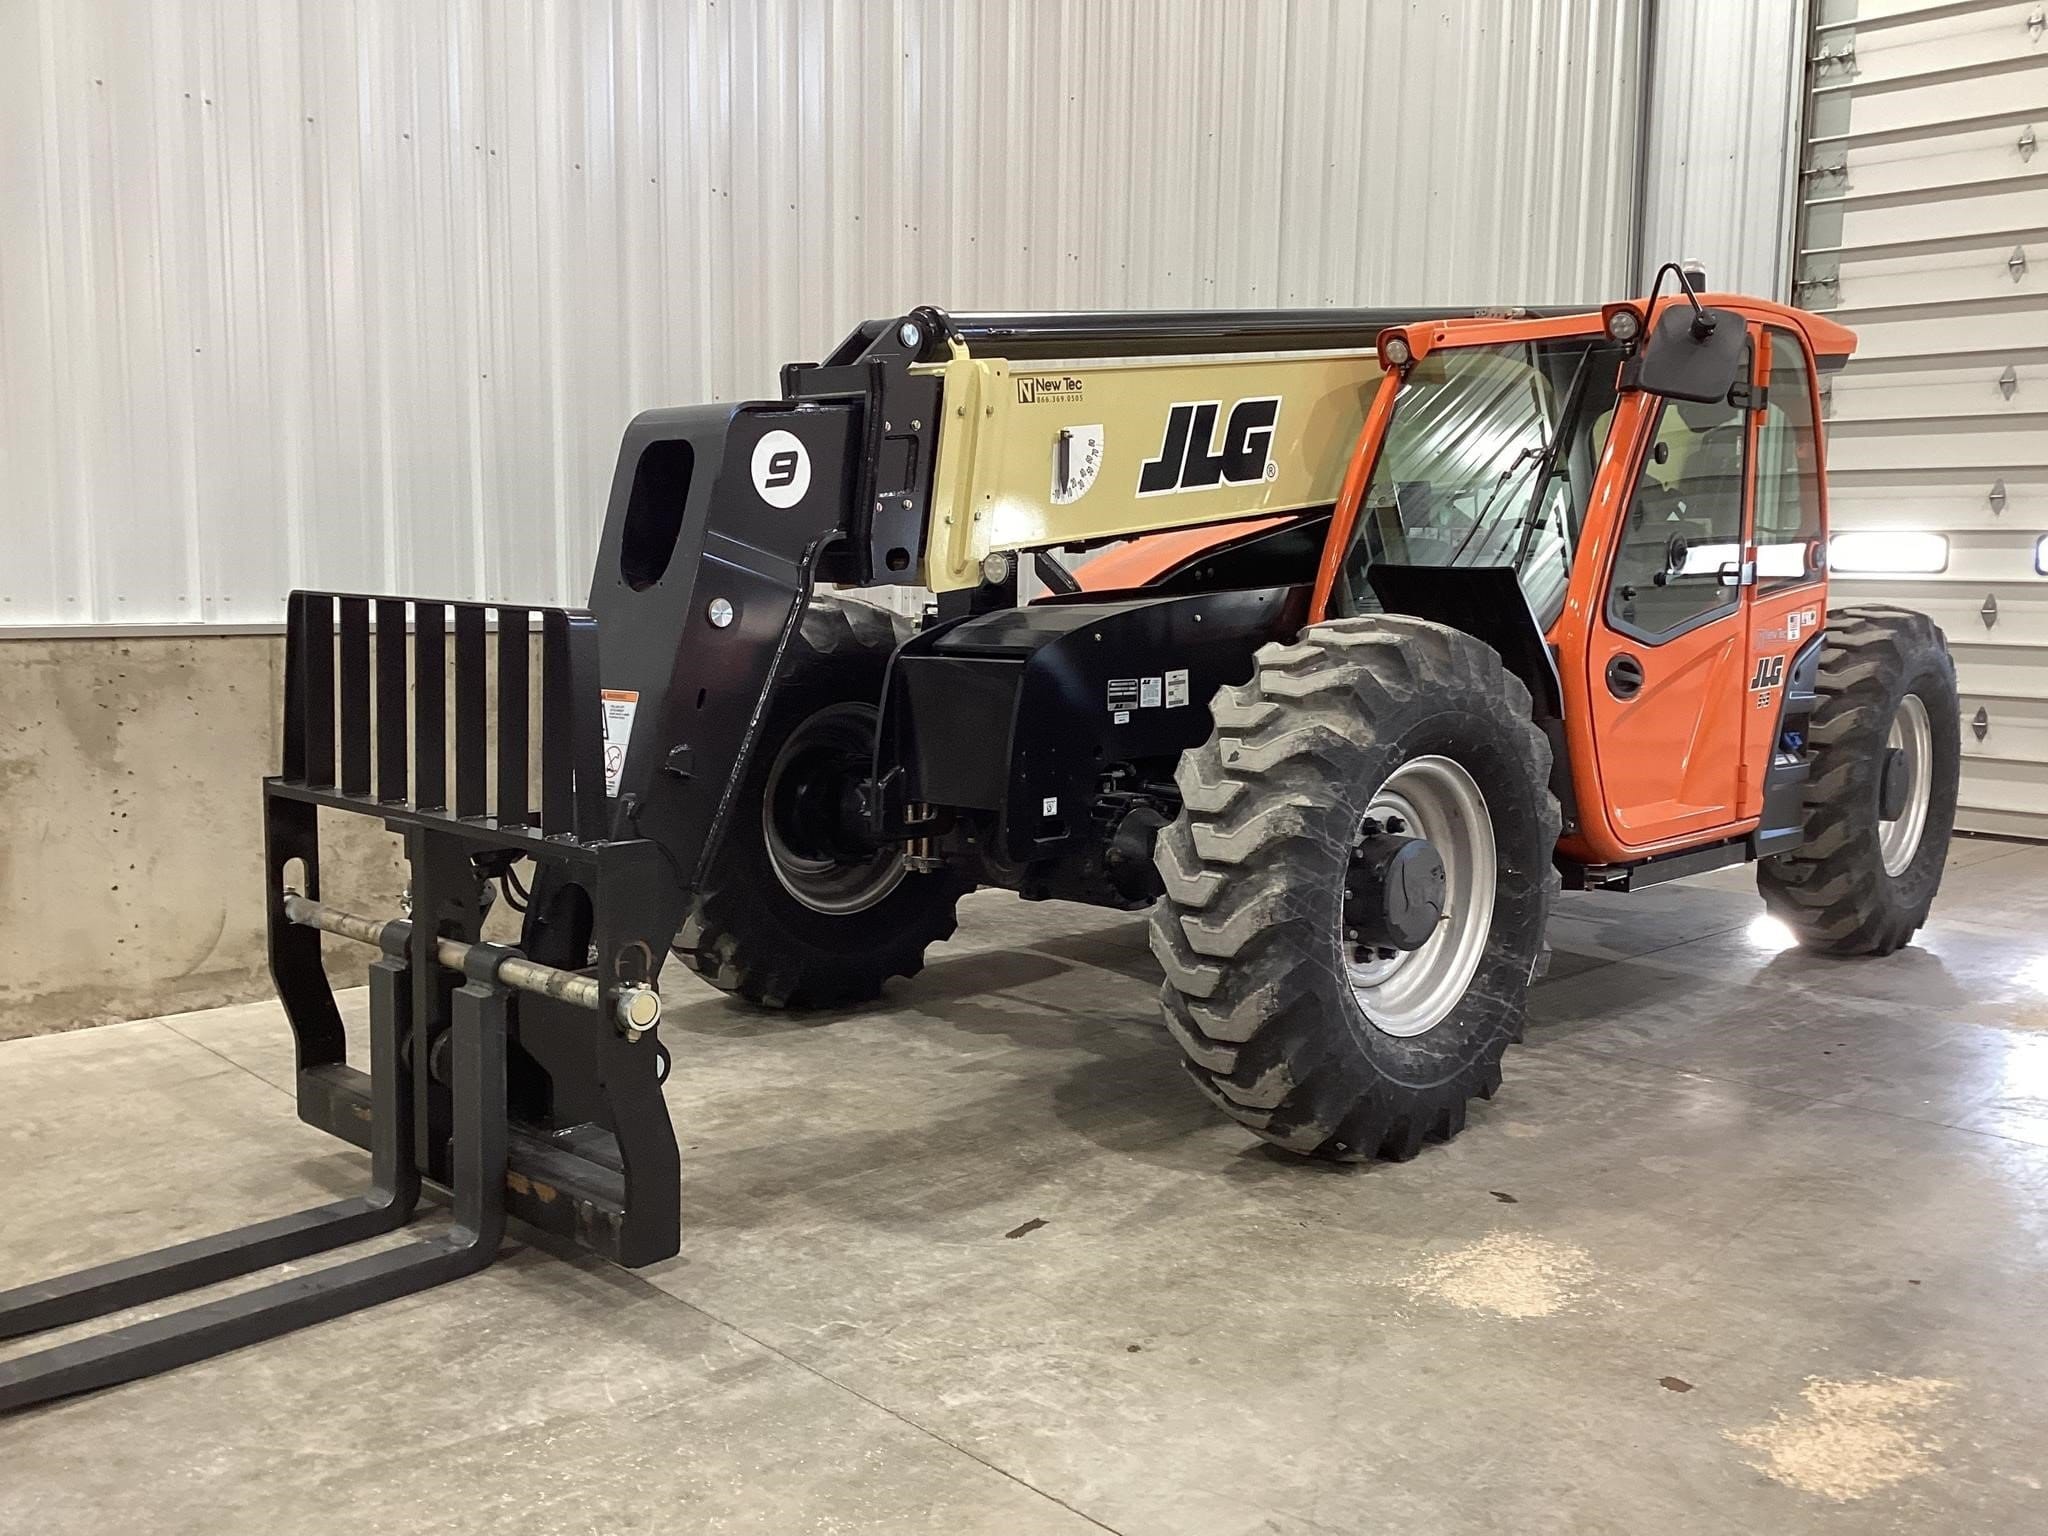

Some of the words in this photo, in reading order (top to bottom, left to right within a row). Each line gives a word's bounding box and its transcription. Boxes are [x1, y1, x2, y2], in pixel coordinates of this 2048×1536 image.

[1036, 378, 1061, 391] New
[1063, 377, 1082, 390] Tec
[765, 451, 798, 488] 9
[1751, 656, 1784, 690] JLG
